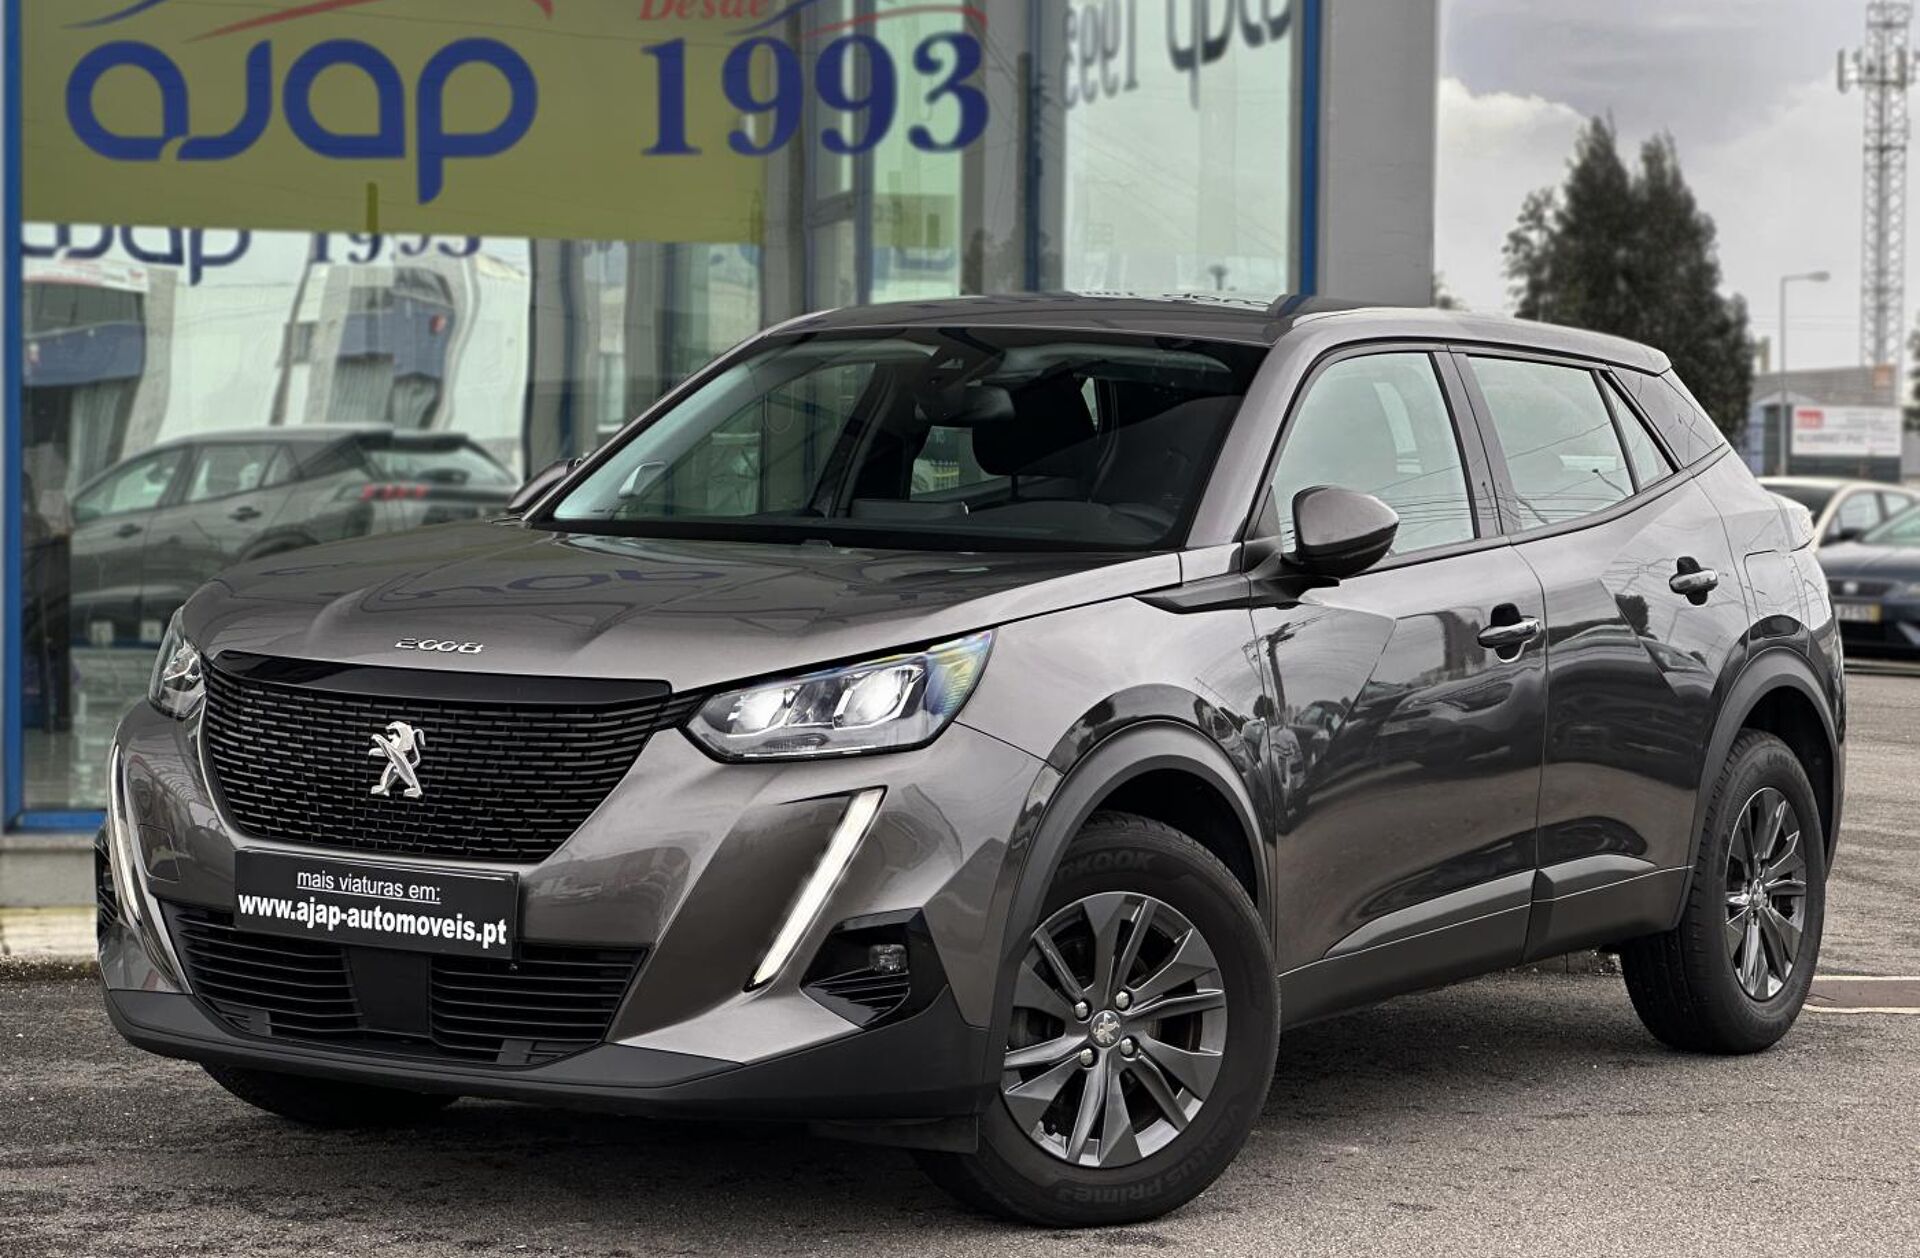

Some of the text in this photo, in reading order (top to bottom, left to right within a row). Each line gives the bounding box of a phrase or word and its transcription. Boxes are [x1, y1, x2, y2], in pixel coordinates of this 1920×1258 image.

[641, 31, 989, 156] 1993
[395, 637, 484, 654] 2008
[297, 870, 441, 901] mais viaturas em:
[238, 895, 507, 949] www.ajap-automoveis.pt
